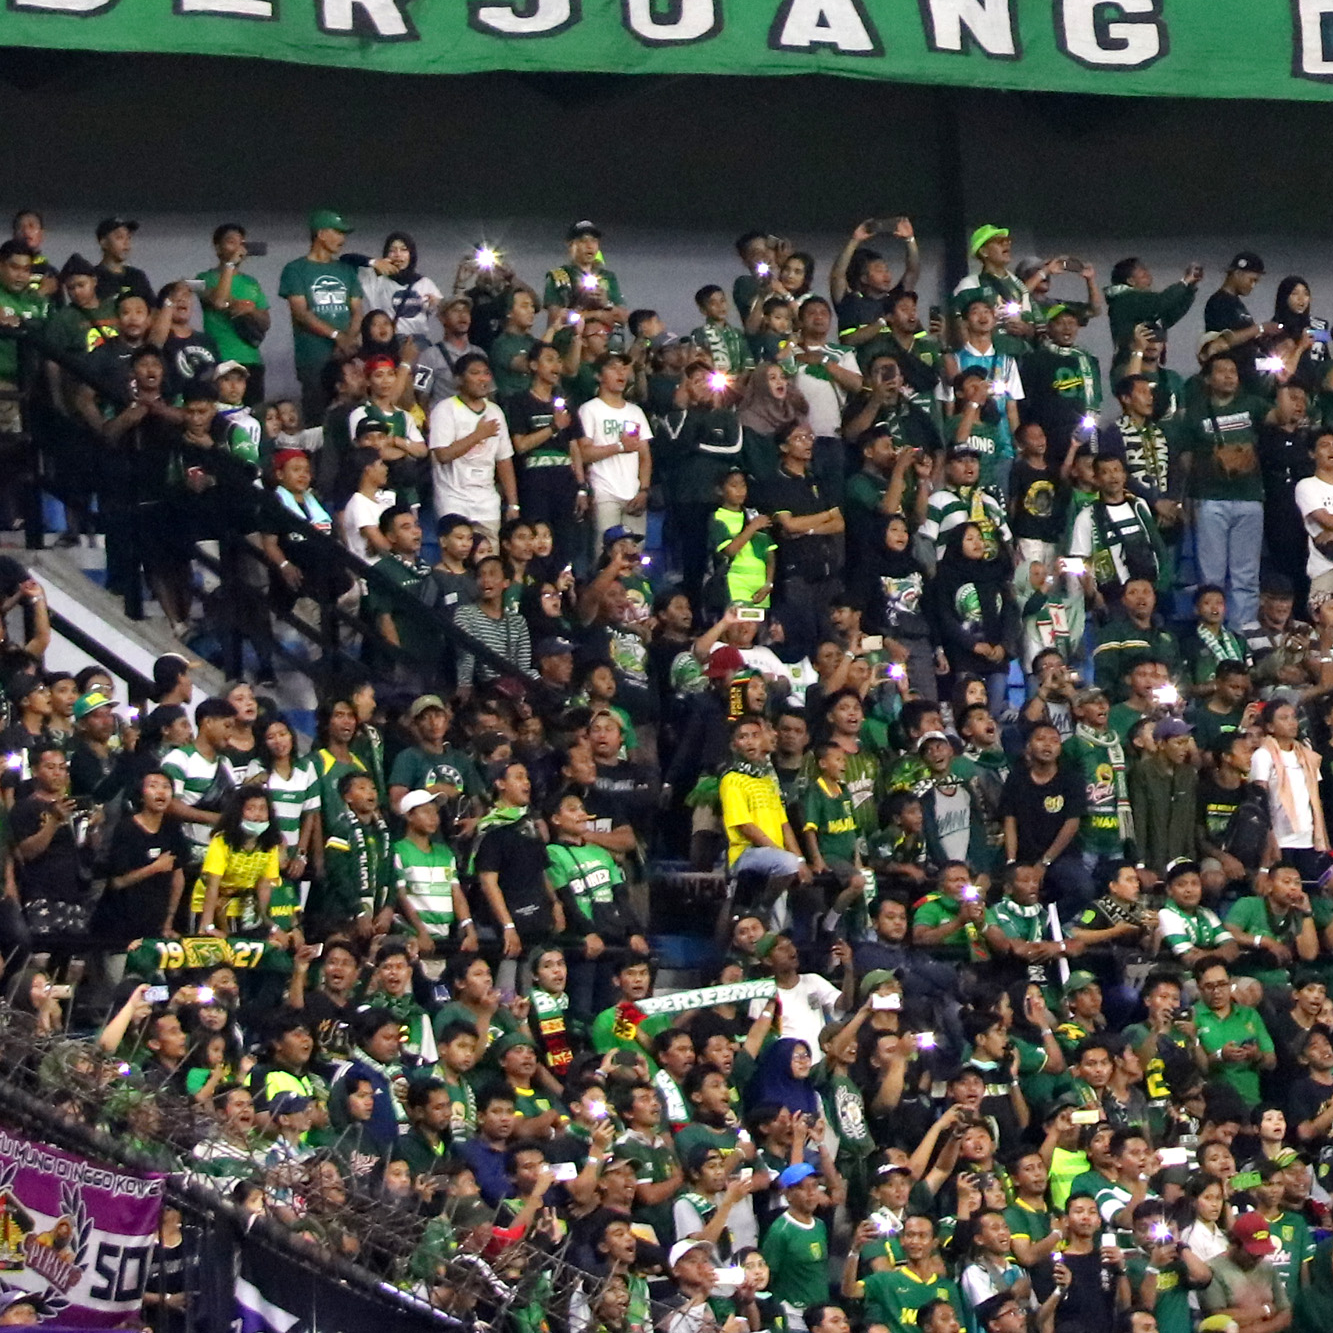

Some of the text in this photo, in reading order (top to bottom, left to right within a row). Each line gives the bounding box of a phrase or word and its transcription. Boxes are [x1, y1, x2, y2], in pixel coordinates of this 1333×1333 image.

[157, 941, 184, 969] 19
[234, 941, 265, 968] 27
[645, 983, 777, 1014] PERSEBAYA
